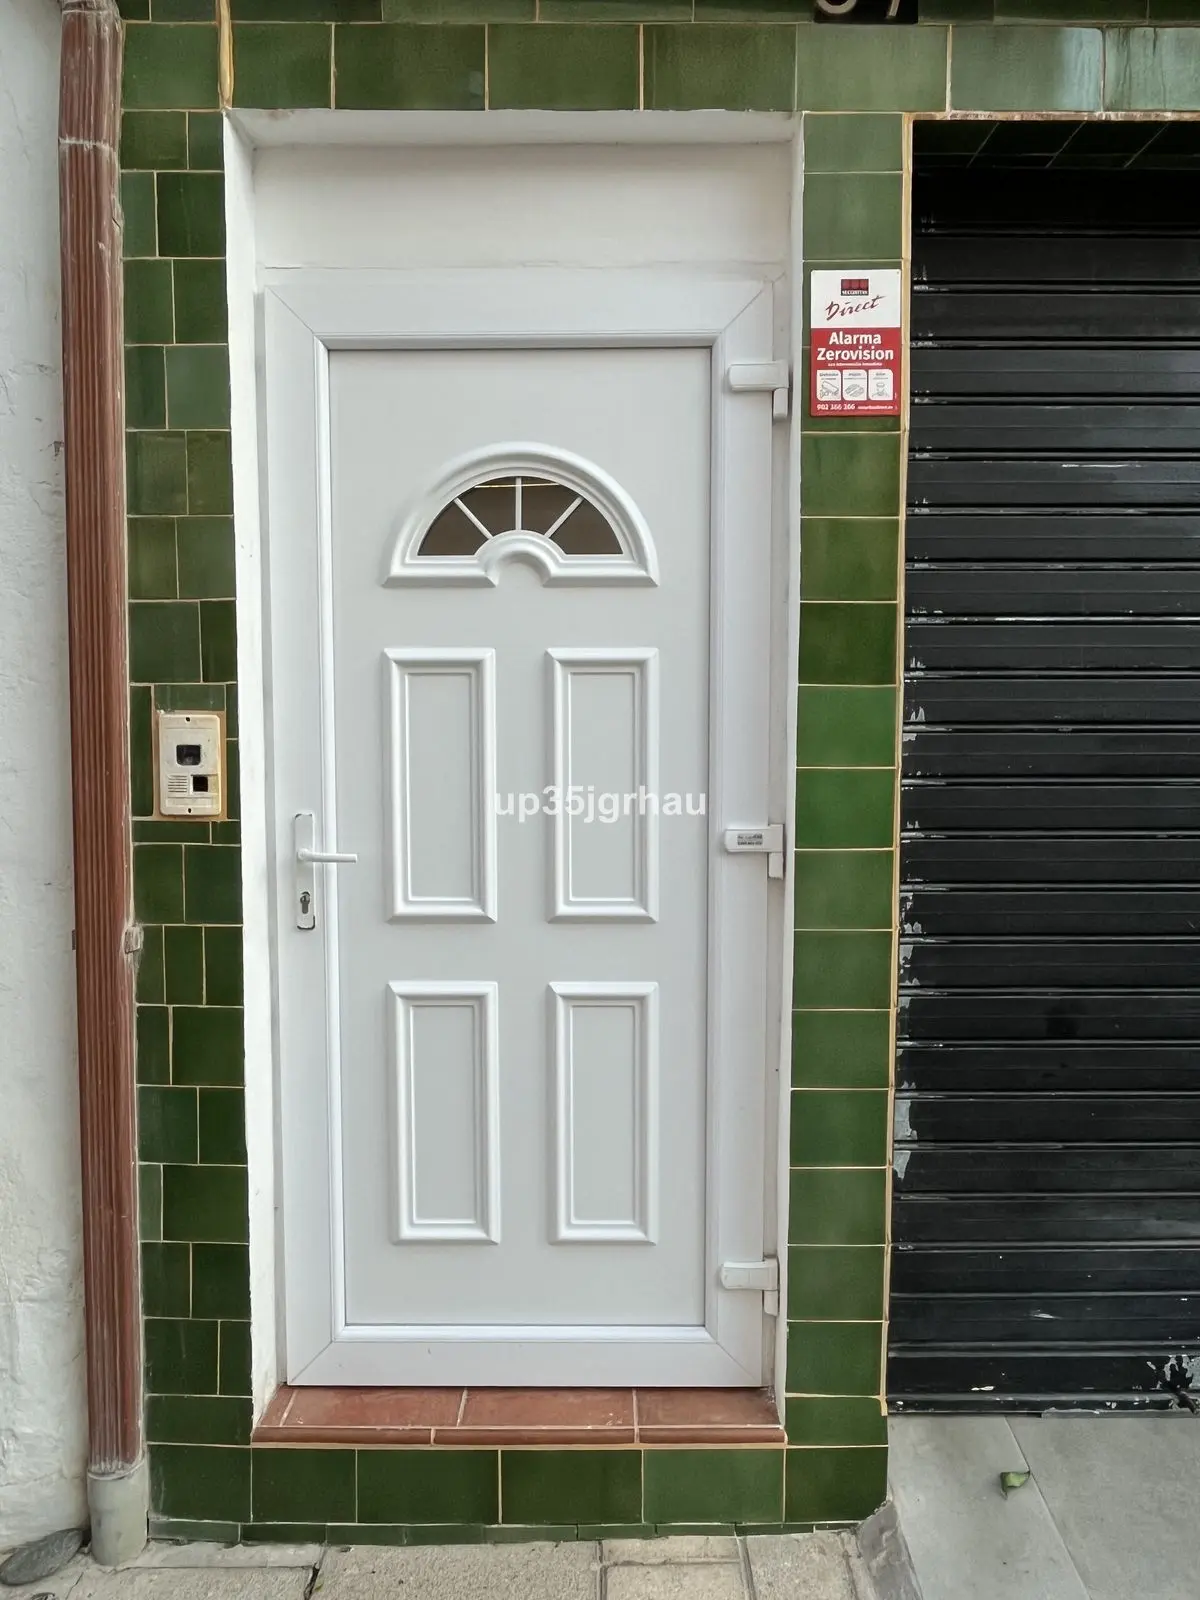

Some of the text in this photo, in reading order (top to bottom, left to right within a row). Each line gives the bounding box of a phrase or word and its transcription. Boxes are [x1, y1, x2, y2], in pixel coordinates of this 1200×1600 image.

[825, 294, 885, 321] Direct
[829, 331, 881, 345] Alarma
[817, 346, 894, 360] Zerovision
